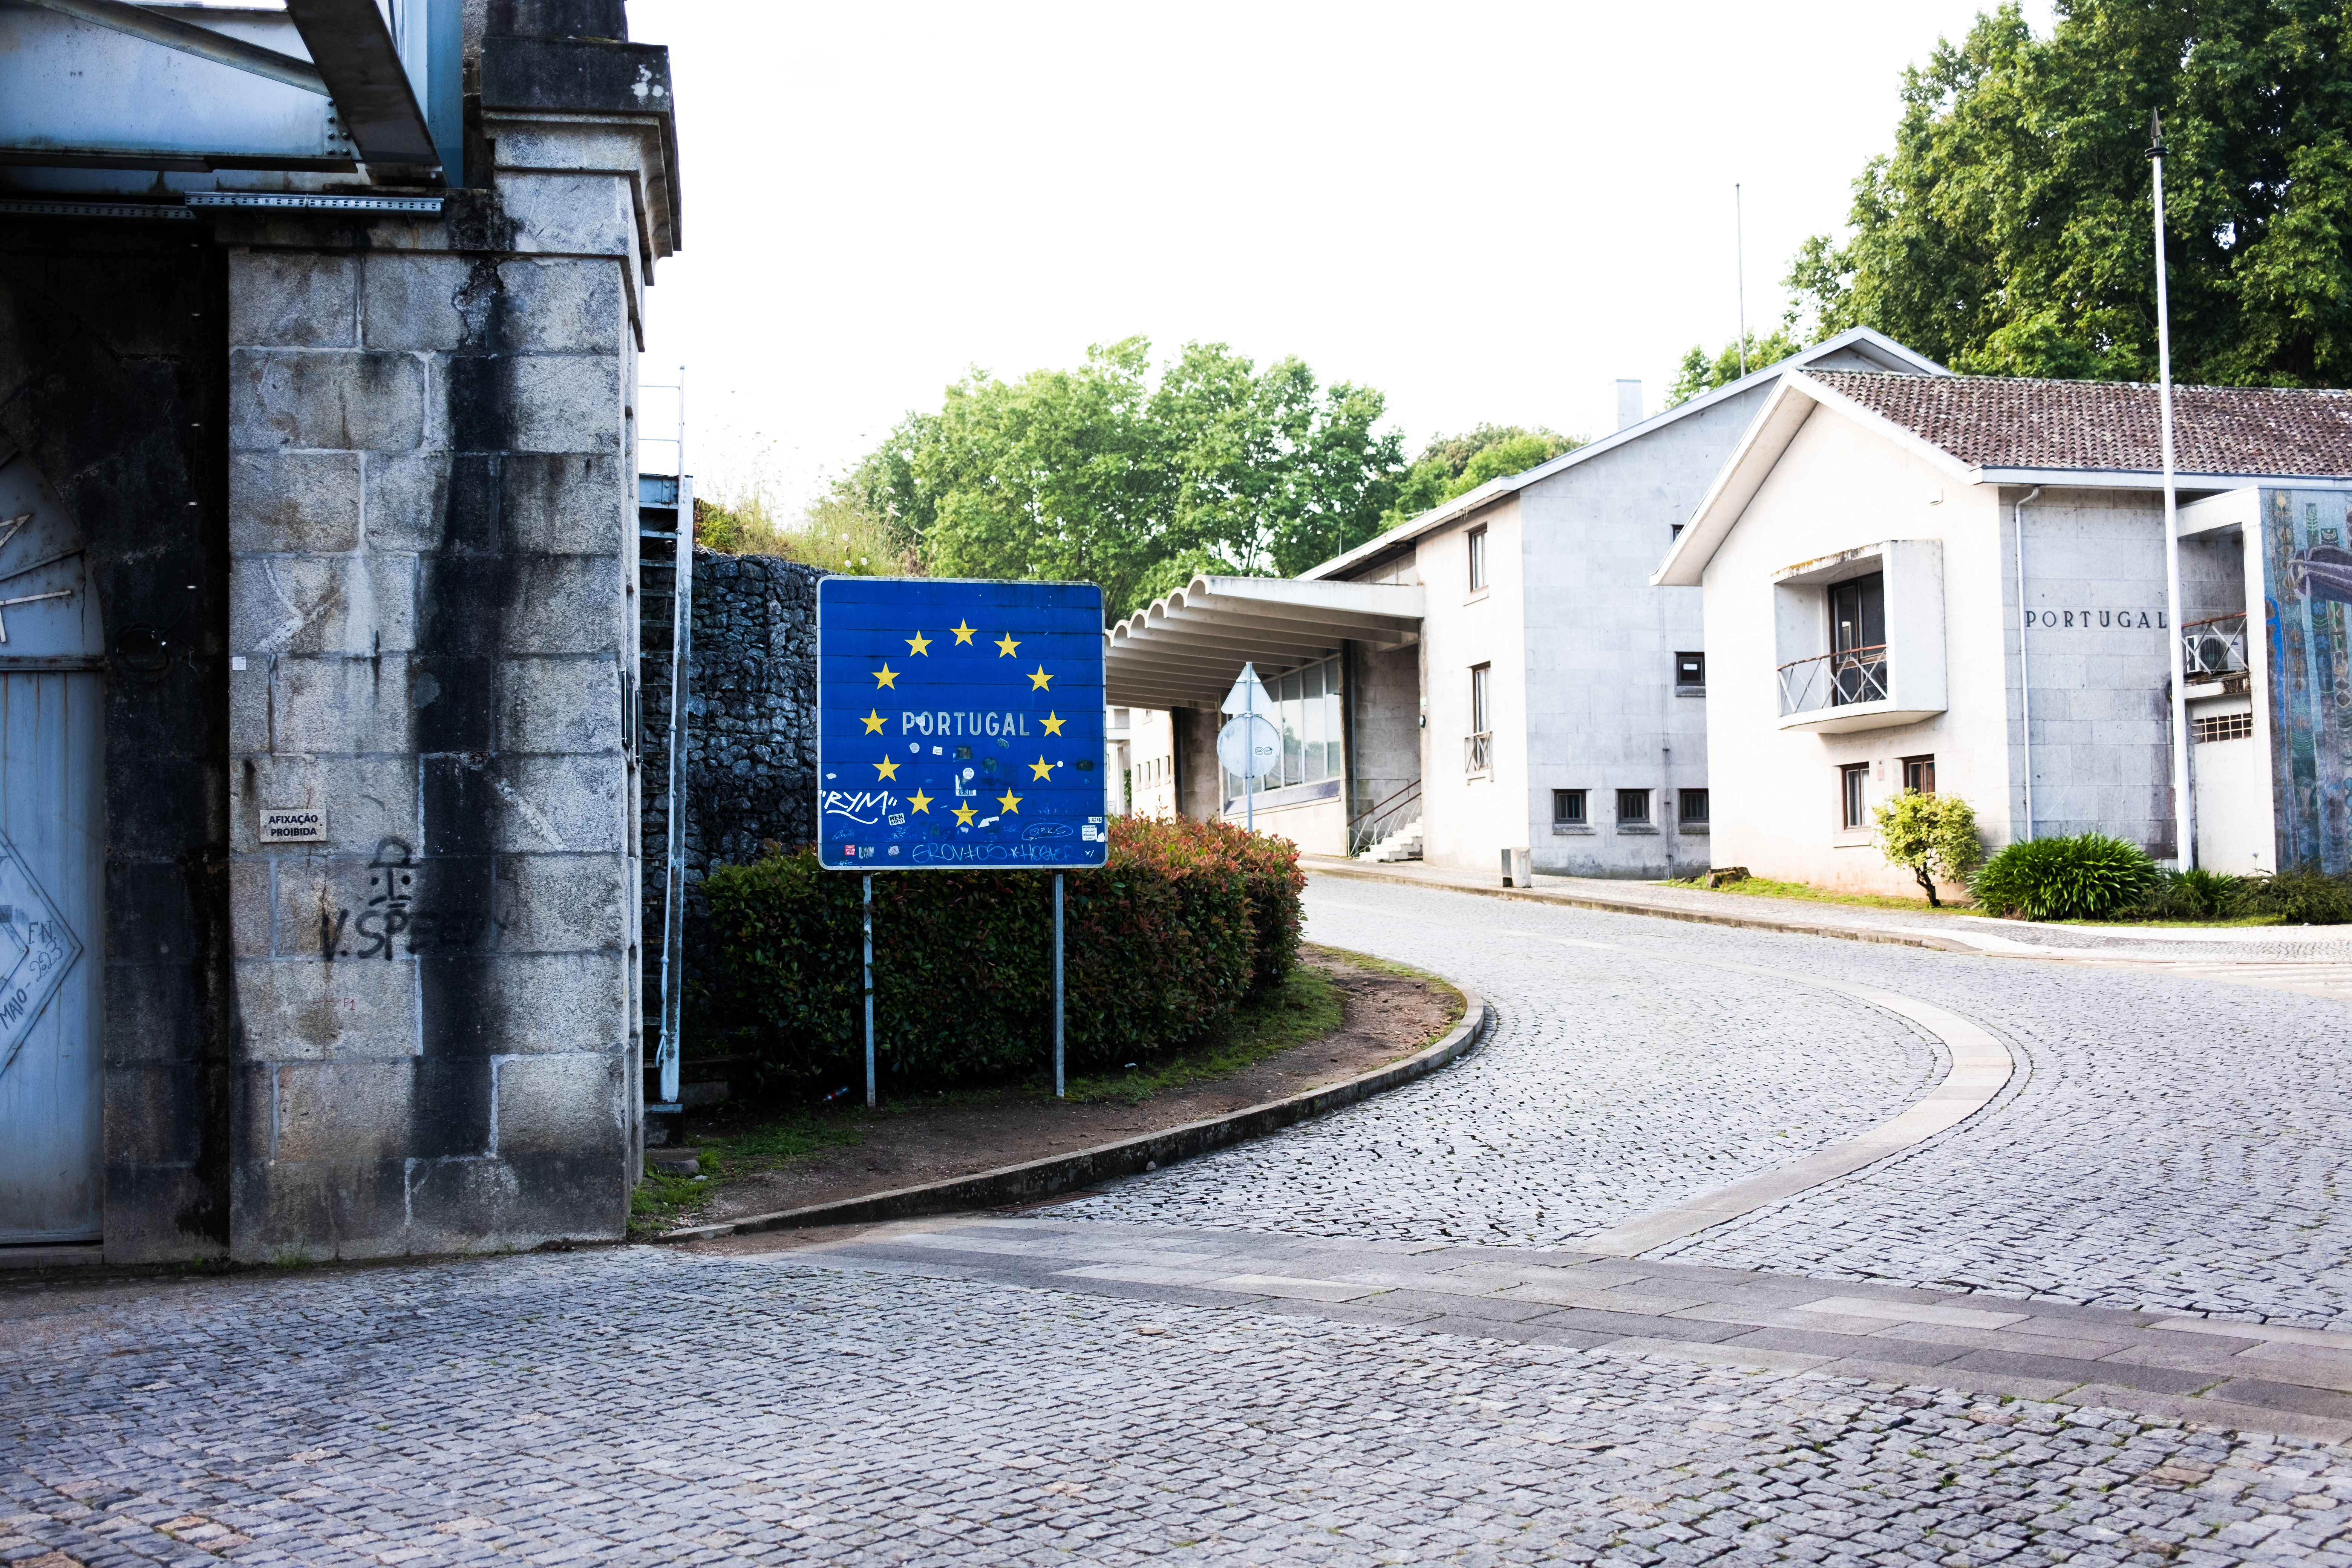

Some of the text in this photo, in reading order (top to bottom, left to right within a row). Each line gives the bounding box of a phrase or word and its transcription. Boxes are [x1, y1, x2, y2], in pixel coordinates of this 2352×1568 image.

[2026, 611, 2168, 629] PORTUGAL
[902, 711, 1030, 736] PORTUGAL
[268, 813, 318, 825] AFIXAÇÃO
[271, 827, 317, 836] PROIBIDA
